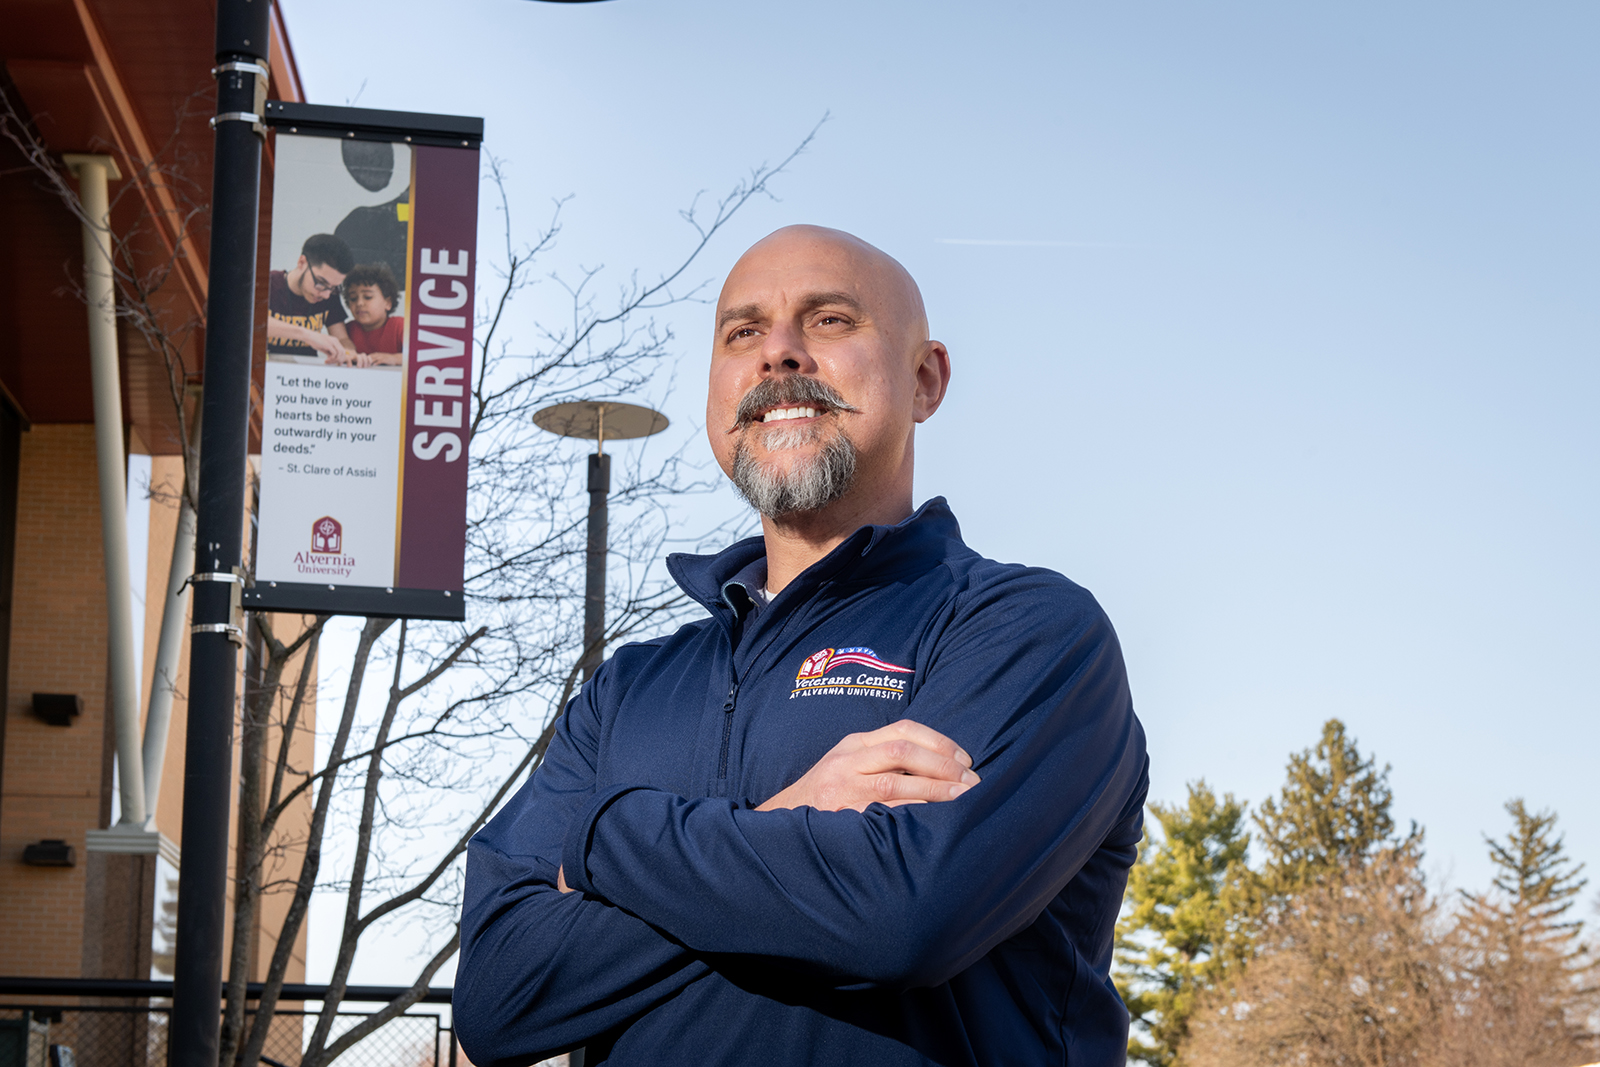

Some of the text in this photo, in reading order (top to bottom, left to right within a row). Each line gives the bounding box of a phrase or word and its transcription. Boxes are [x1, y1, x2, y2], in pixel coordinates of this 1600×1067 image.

[412, 248, 469, 463] SERVICE
[303, 377, 321, 388] the
[325, 379, 349, 390] love
[275, 394, 372, 409] you have in your
[275, 408, 372, 425] hearts be shown
[274, 427, 377, 443] outwardly in your
[287, 463, 300, 473] St.
[303, 464, 330, 475] Clare
[333, 466, 344, 476] of
[346, 467, 377, 478] Assisi
[293, 551, 356, 566] Alvernia
[297, 564, 352, 578] University
[795, 673, 907, 690] Veterans Center
[789, 687, 904, 701] AT ALVERNIA UNIVERSITY
